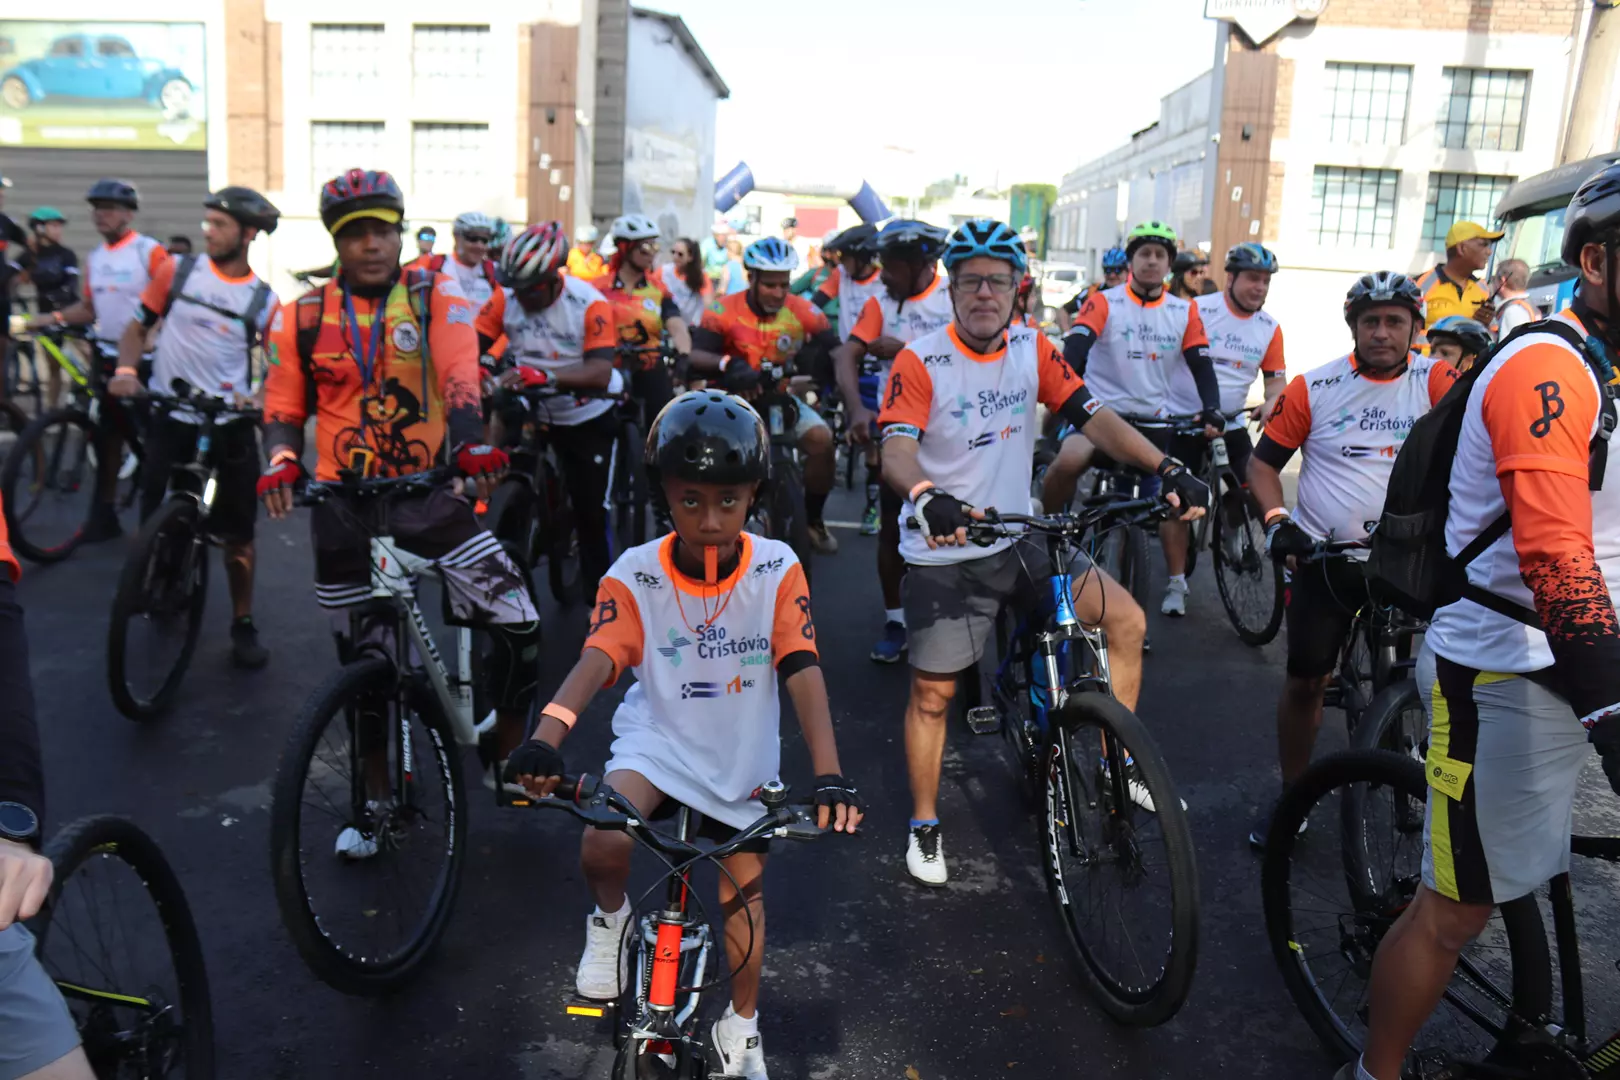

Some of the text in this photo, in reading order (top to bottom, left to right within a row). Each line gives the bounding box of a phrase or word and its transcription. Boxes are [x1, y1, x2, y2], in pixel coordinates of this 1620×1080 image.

[1311, 375, 1343, 388] RVS
[1361, 407, 1386, 420] São
[1359, 415, 1416, 431] Cristóvã
[695, 624, 727, 642] São
